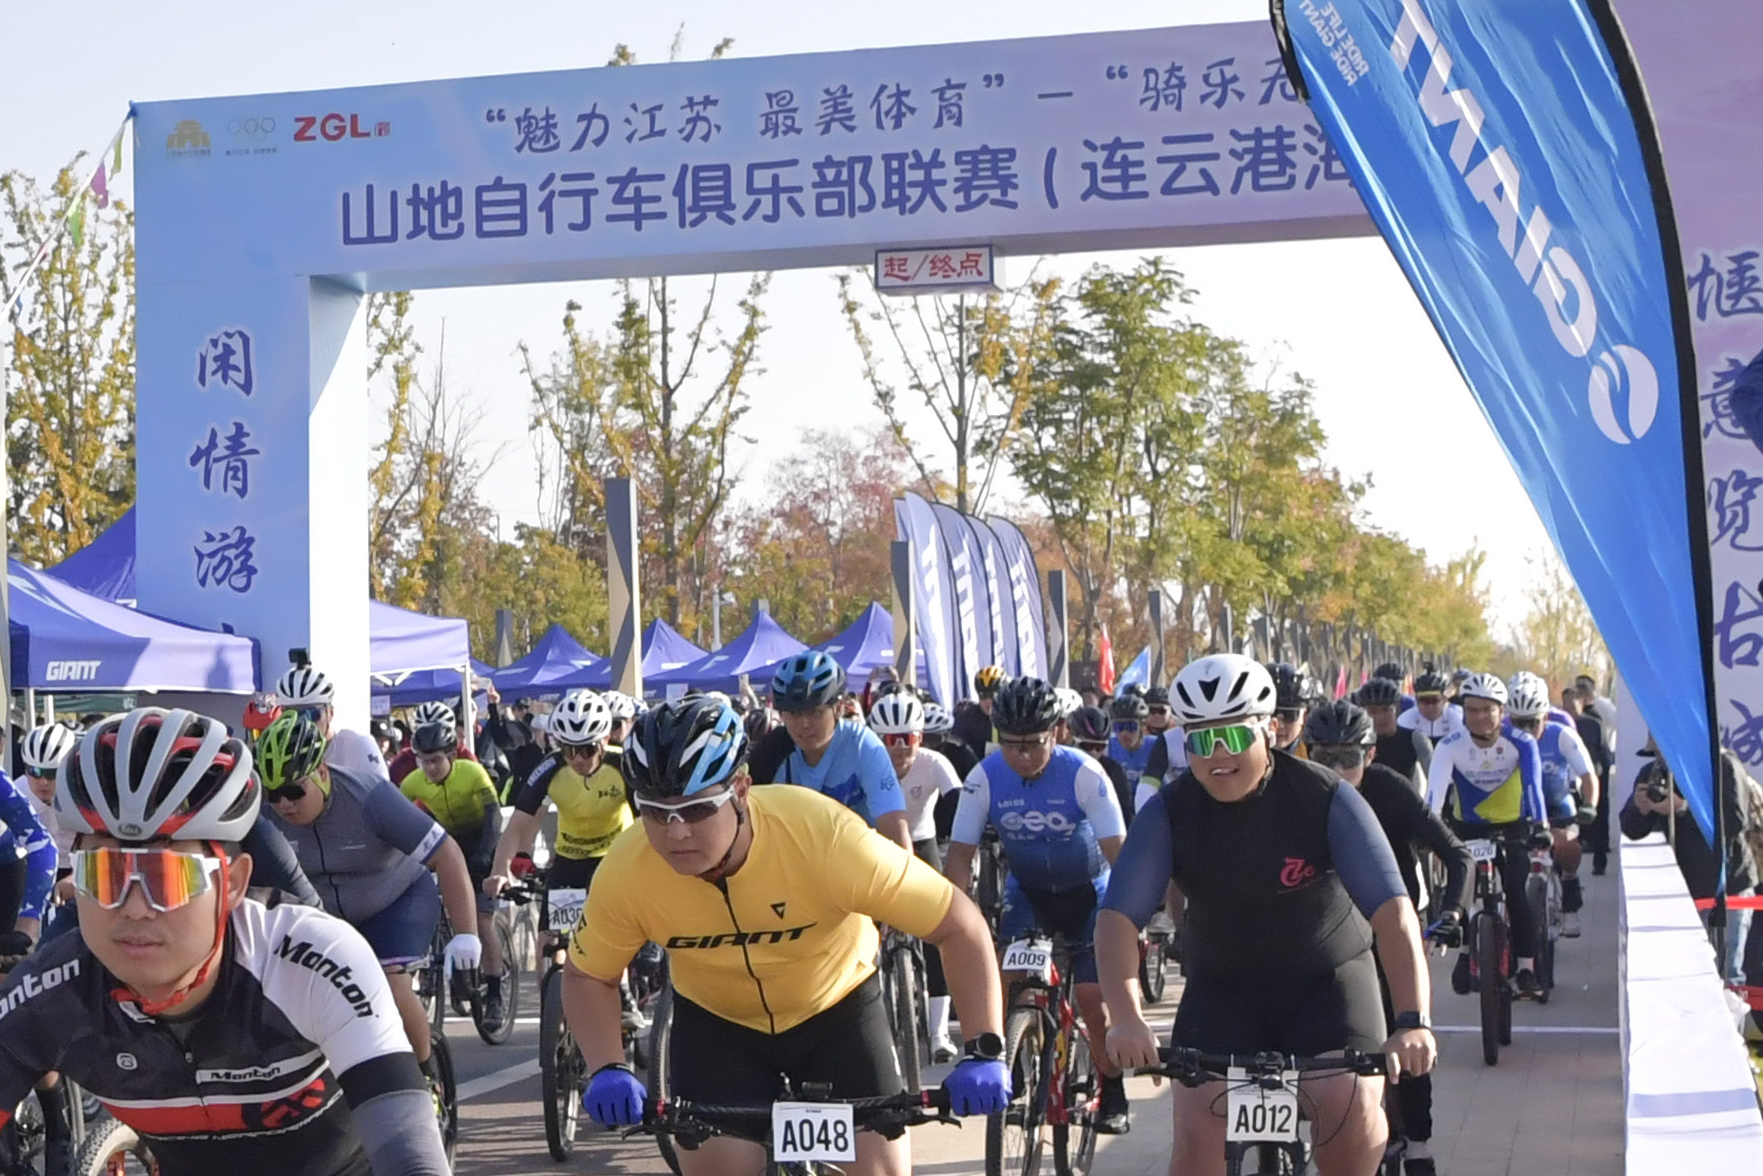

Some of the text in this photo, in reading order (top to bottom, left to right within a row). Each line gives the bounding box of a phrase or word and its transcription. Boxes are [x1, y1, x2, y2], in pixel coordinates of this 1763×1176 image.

[293, 113, 371, 142] ZGL
[882, 250, 986, 282] 起/终点
[189, 329, 260, 634] 闲情游
[45, 659, 102, 681] GIANT
[666, 921, 818, 950] GIANT
[1007, 951, 1046, 967] A009
[272, 934, 377, 1020] Monton
[210, 1065, 282, 1082] Monton
[1234, 1104, 1293, 1134] A012
[781, 1118, 849, 1153] A048
